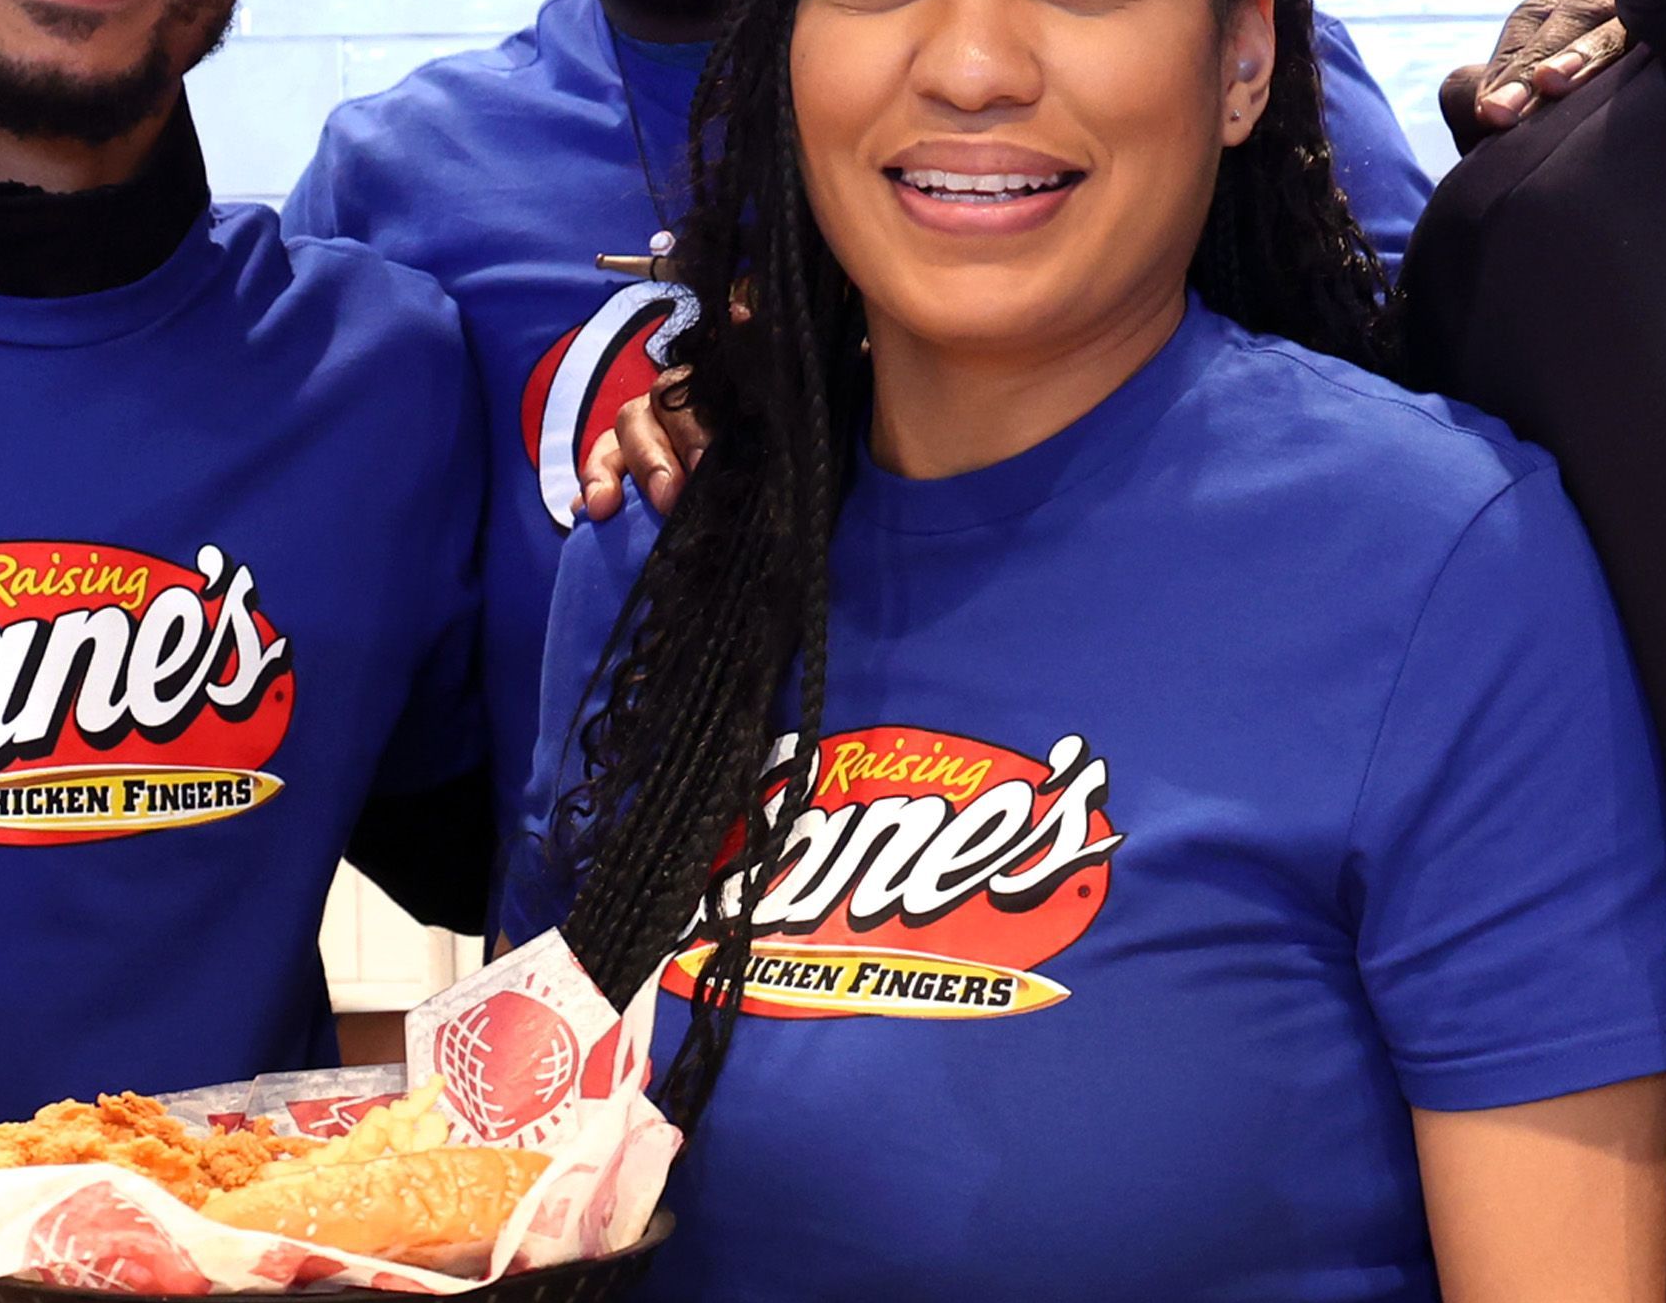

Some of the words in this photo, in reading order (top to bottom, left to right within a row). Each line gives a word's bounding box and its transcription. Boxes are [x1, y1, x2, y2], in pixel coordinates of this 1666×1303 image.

[123, 776, 254, 813] FINGERS
[819, 737, 993, 803] Raising
[743, 955, 845, 993] ICKEN
[848, 962, 1015, 1008] FINGERS
